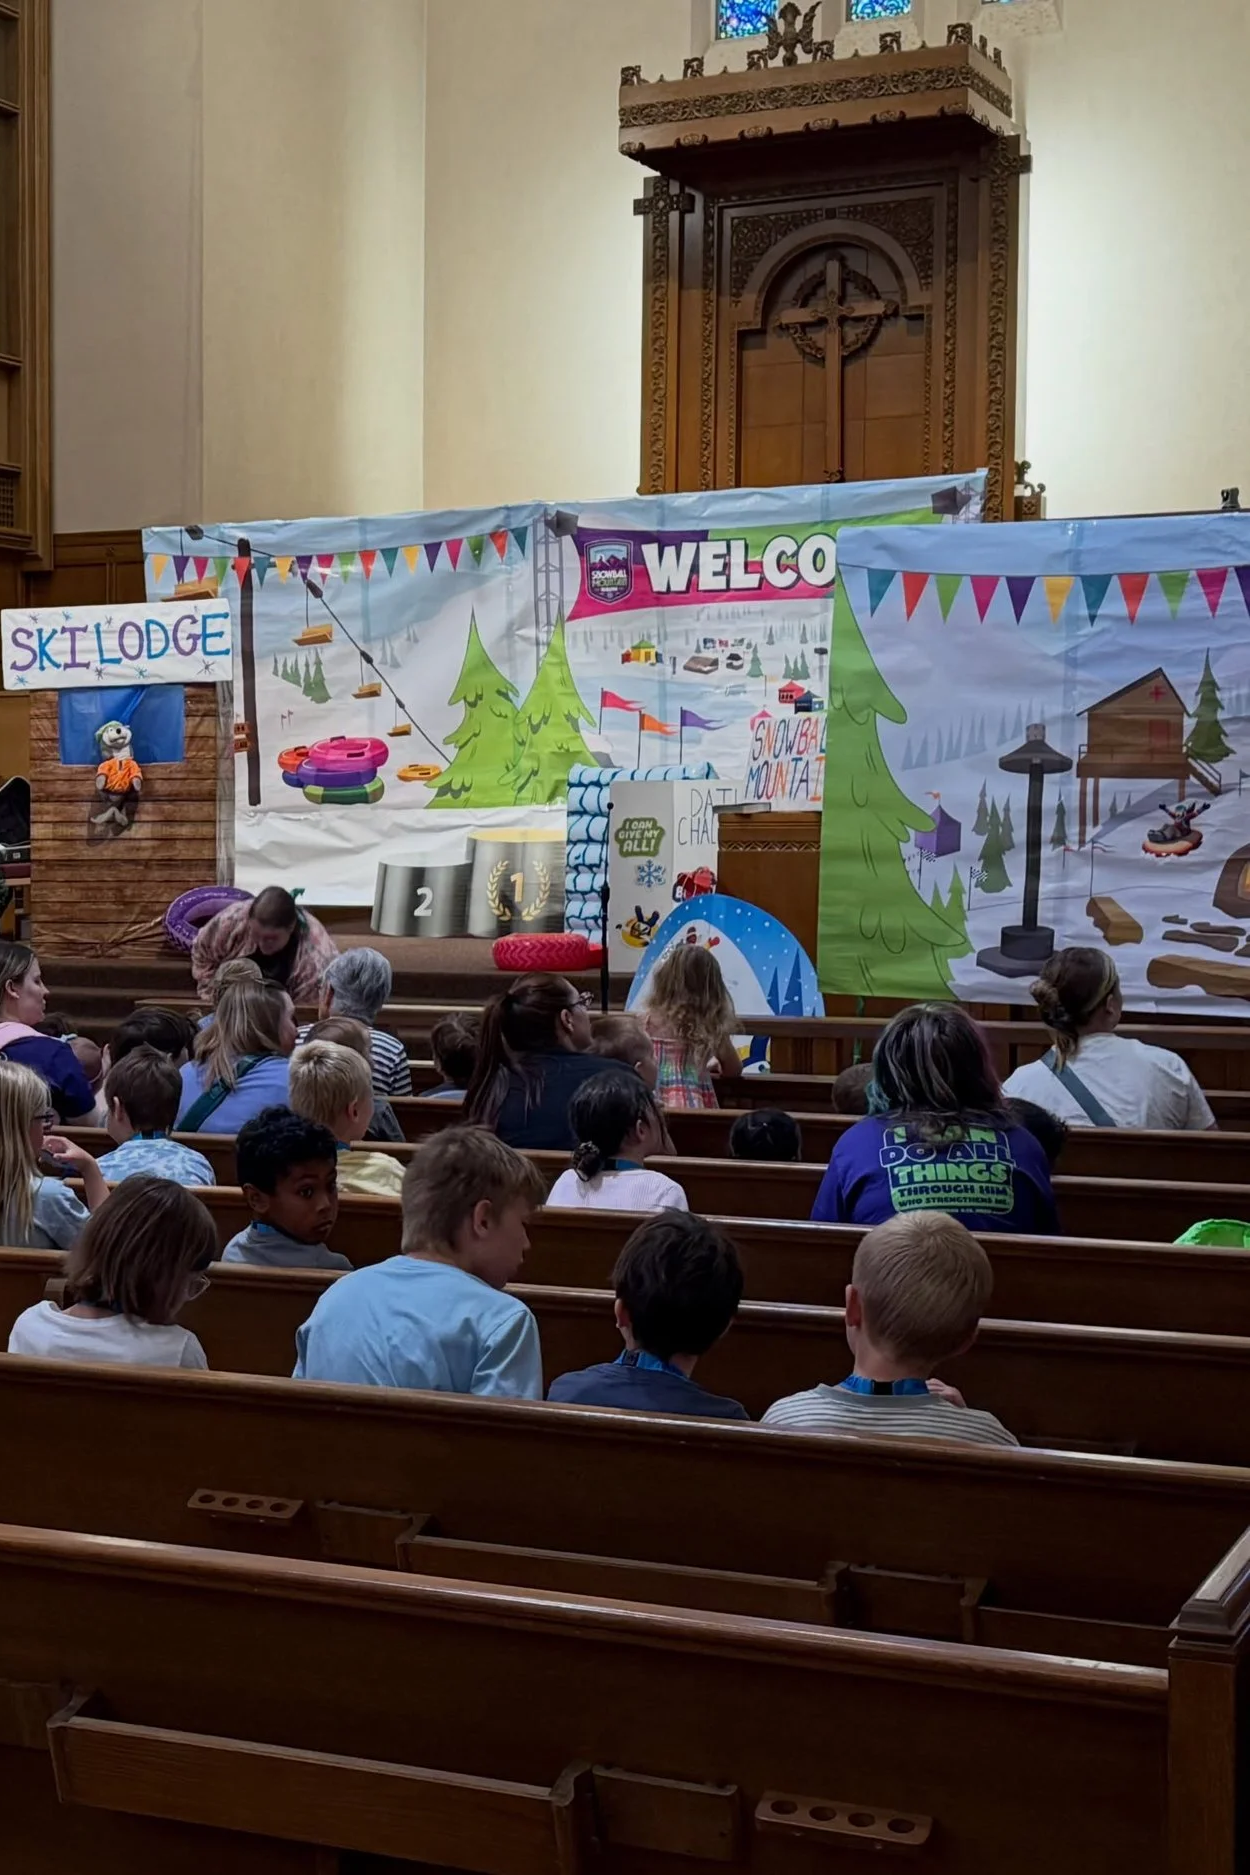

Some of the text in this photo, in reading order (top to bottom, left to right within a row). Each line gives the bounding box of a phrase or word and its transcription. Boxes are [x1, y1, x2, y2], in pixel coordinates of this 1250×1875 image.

[10, 611, 231, 672] SKI LODGE
[618, 829, 660, 839] GIVE MY
[625, 820, 653, 830] I CAN
[510, 872, 524, 903] 1
[413, 887, 434, 917] 2
[893, 1126, 906, 1143] I
[879, 1142, 1016, 1168] DO ALL
[893, 1163, 1008, 1185] THINGS
[897, 1184, 1009, 1198] THROUGH HIM
[898, 1198, 923, 1208] WHO
